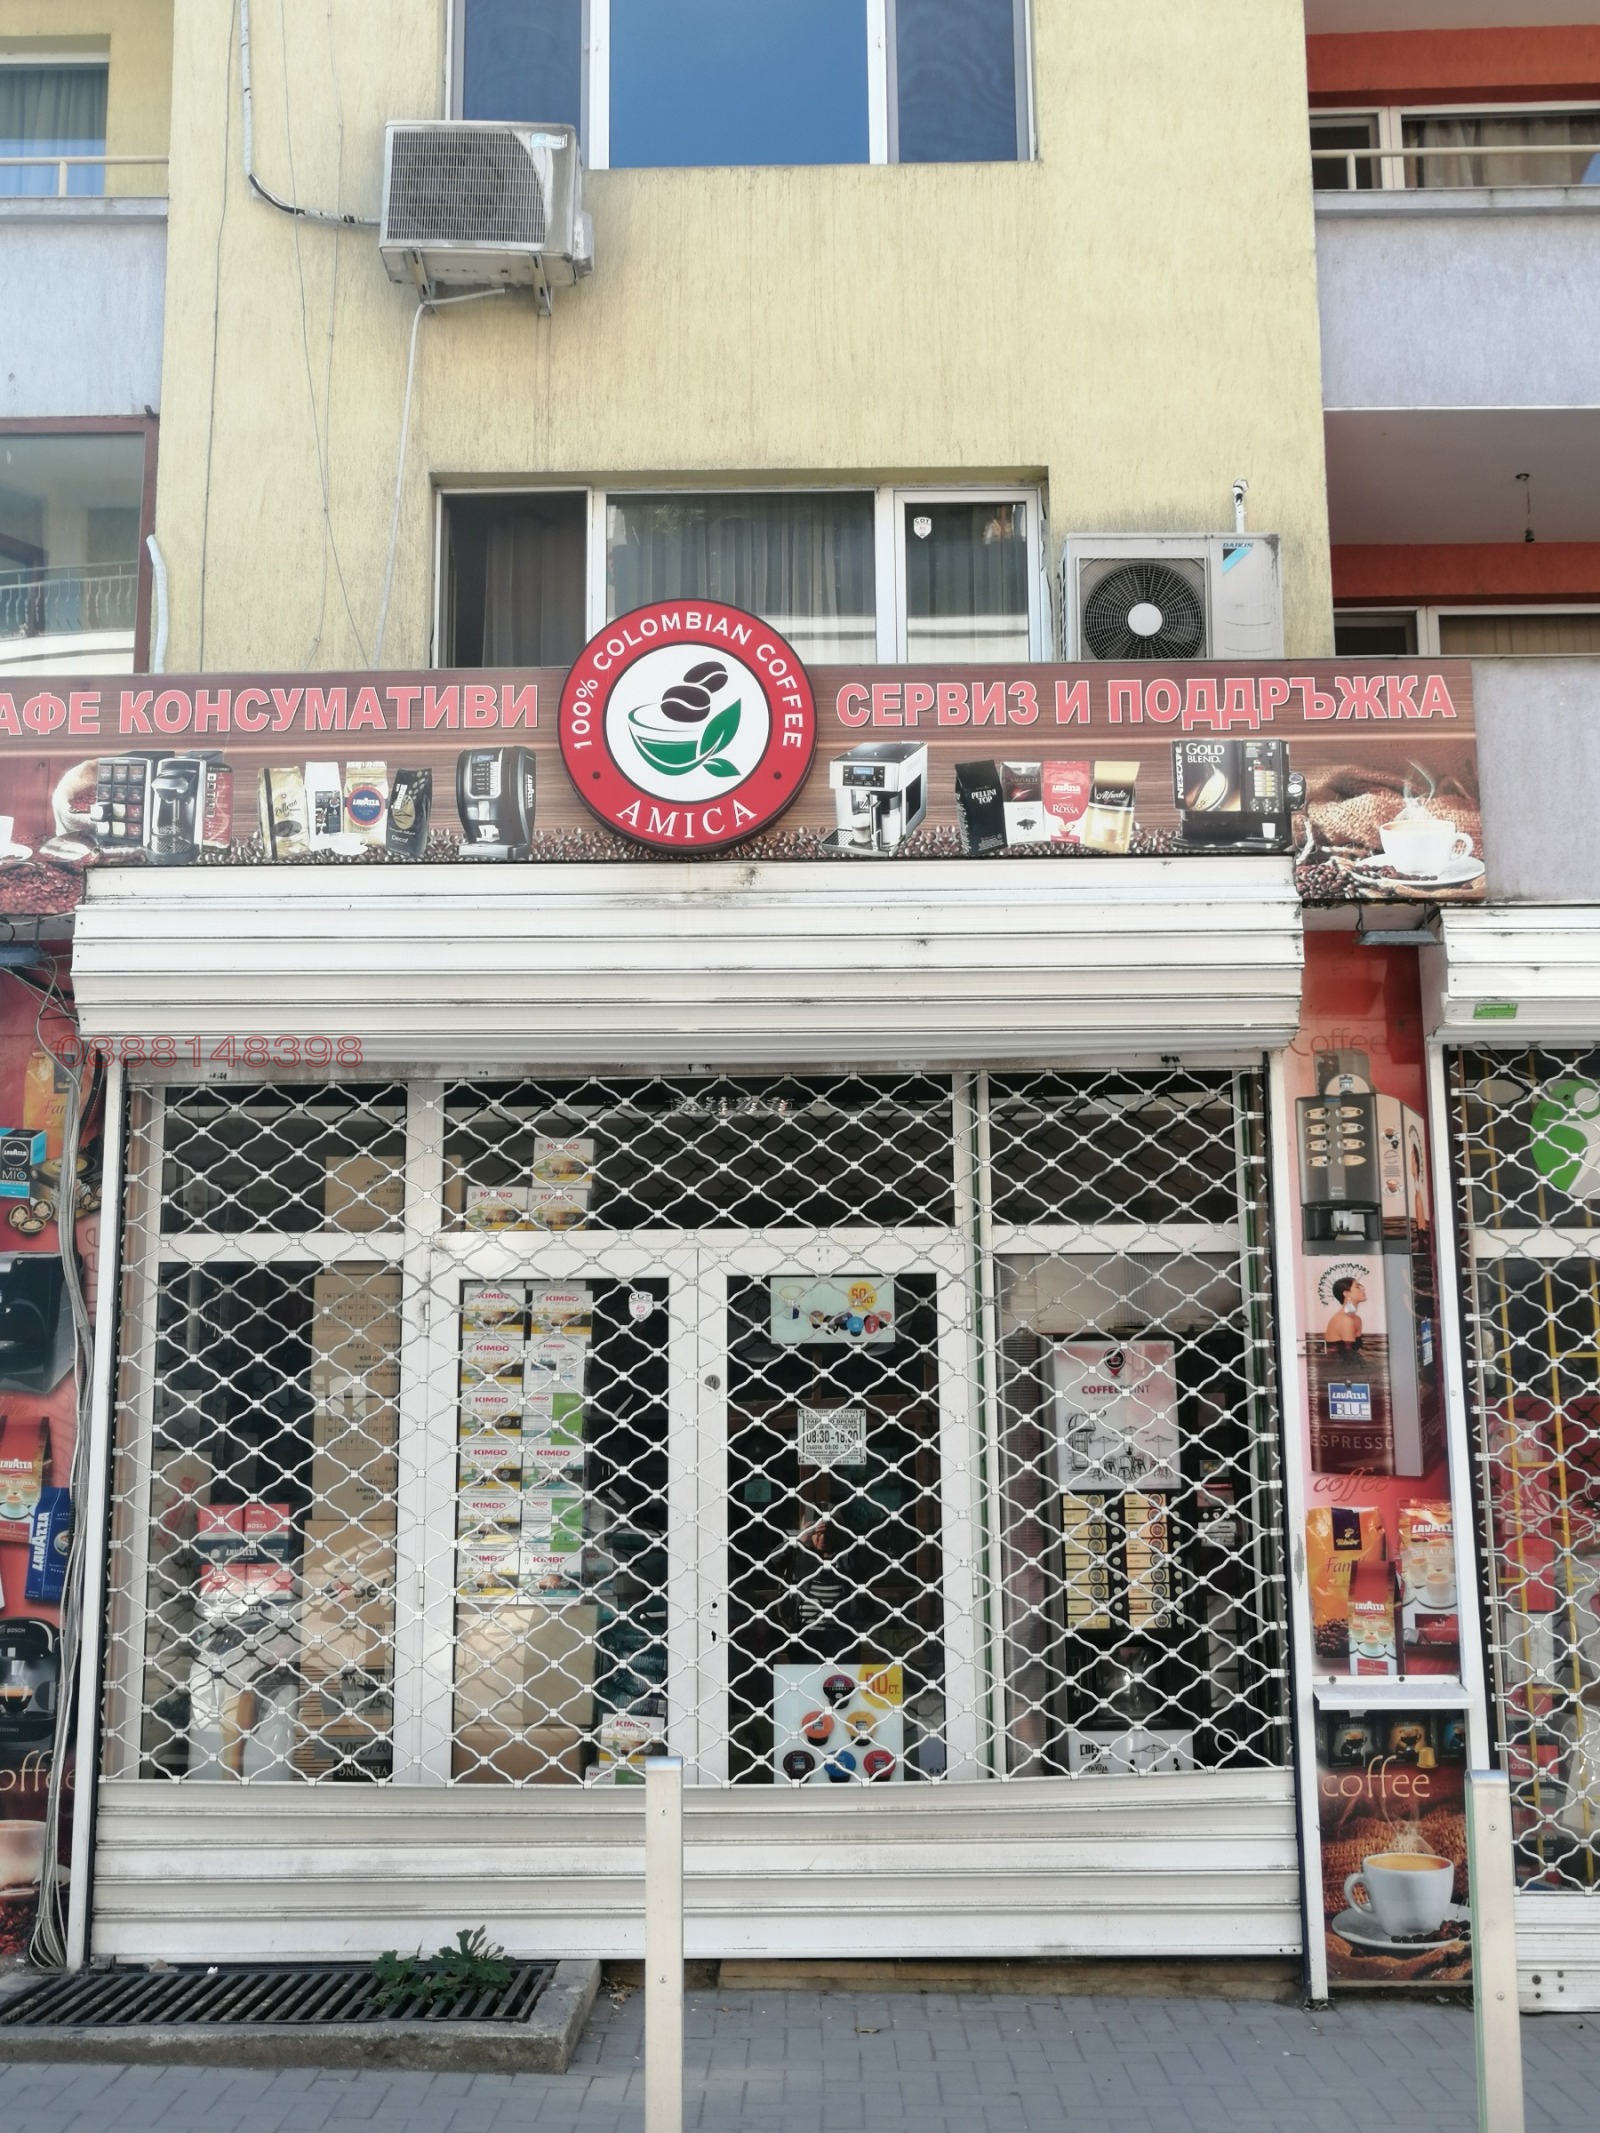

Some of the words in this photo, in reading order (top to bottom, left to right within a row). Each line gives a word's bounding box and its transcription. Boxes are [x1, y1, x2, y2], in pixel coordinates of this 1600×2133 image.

[571, 678, 599, 750] 100%
[593, 611, 752, 671] COLOMBIAN
[756, 643, 804, 748] COFFEE
[118, 684, 538, 735] КОНСУМАТИВИ
[835, 680, 1041, 728] СЕРВИЗ
[1054, 680, 1091, 725] И
[1109, 675, 1456, 731] ПОДДРЪЖКА
[1186, 743, 1225, 755] GOLD
[971, 789, 997, 799] PELLINI
[616, 799, 757, 838] AMICA
[1053, 805, 1079, 814] ROSSA
[2, 1171, 27, 1180] MIO
[1332, 1390, 1367, 1400] LAVAZZA
[1333, 1402, 1370, 1416] BLUE
[1313, 1467, 1391, 1501] coffee
[1412, 1522, 1454, 1534] LAVAZZ
[32, 1511, 50, 1572] LAVAZZA
[1321, 1755, 1430, 1798] coffee
